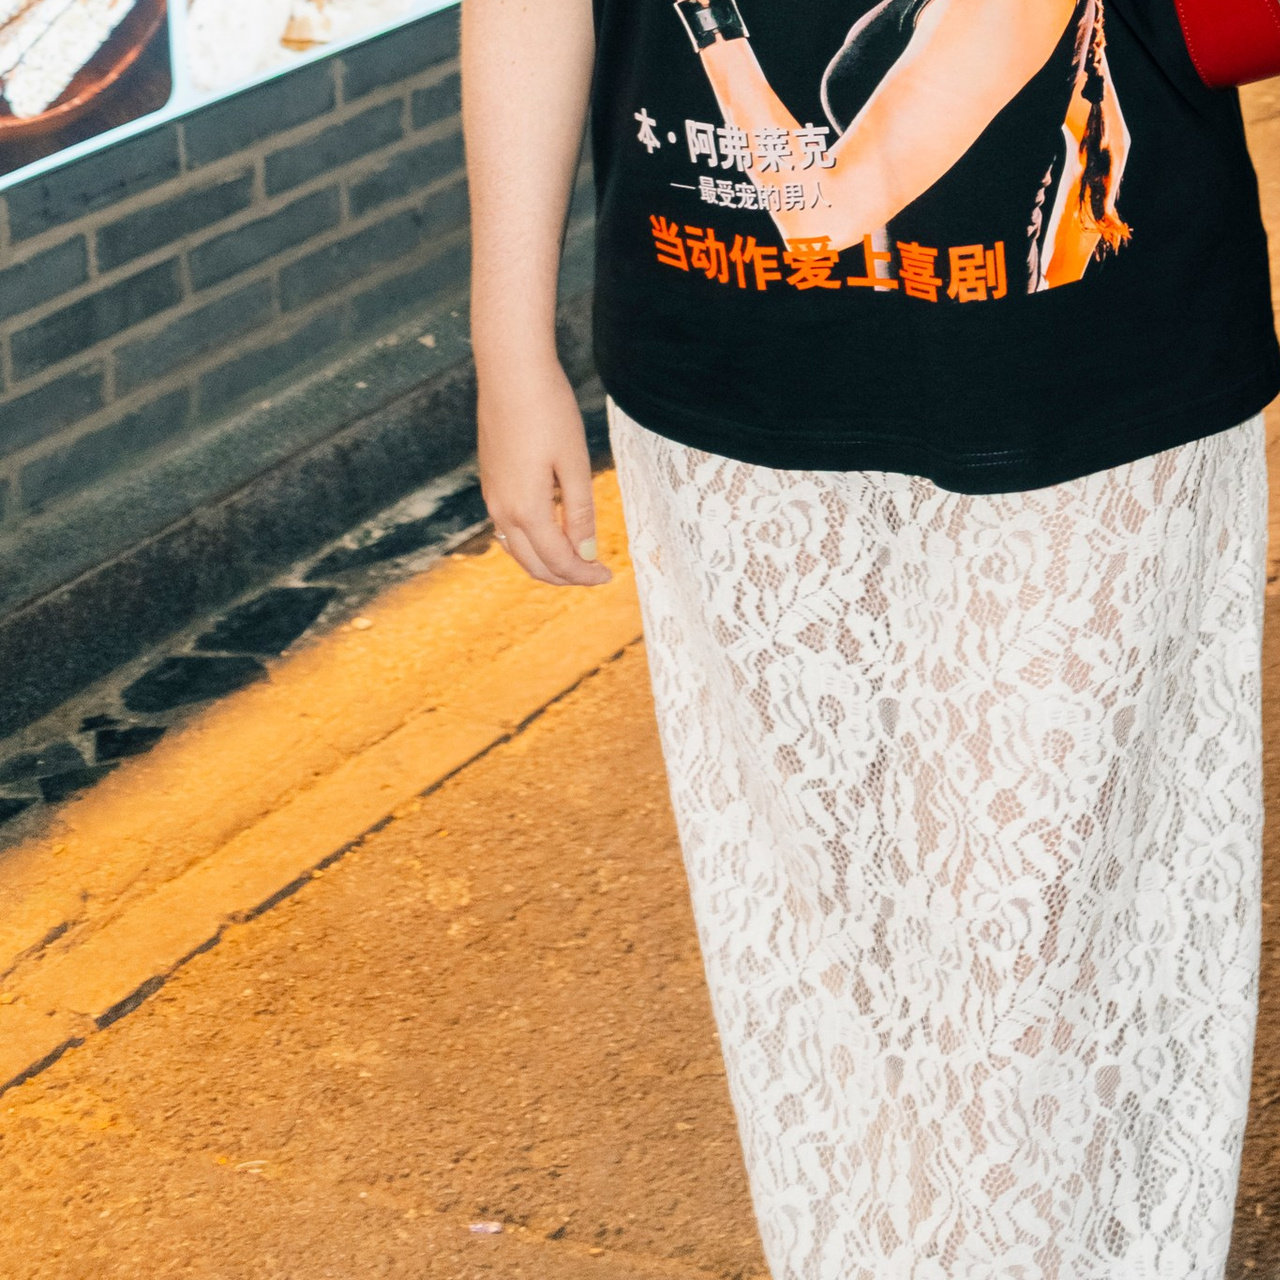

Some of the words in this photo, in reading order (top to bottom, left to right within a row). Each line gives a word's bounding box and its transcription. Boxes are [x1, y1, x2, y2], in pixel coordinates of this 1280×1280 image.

[649, 213, 1009, 304] 当动作爱上喜剧
